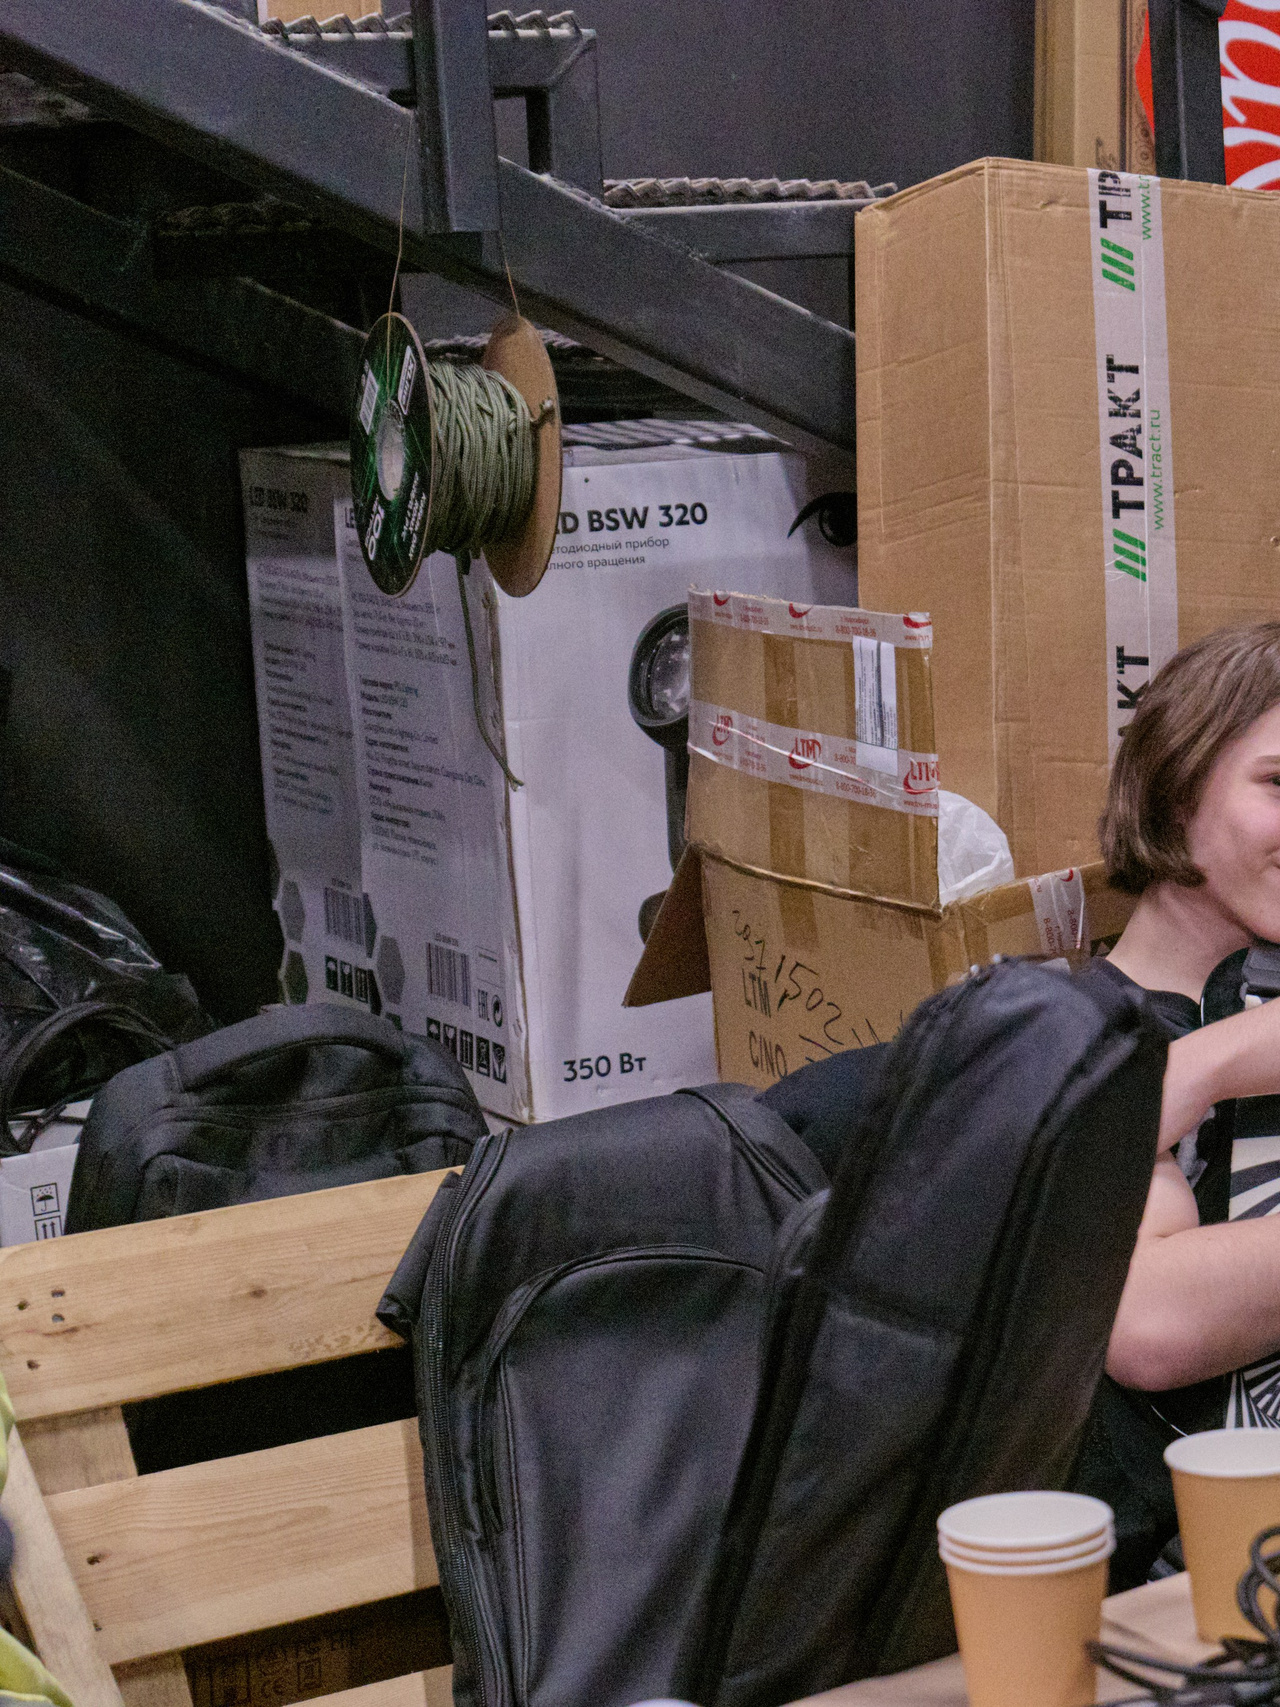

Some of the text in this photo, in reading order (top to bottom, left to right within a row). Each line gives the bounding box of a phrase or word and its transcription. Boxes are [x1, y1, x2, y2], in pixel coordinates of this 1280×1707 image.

[1105, 354, 1145, 519] ТРАКТ
[1149, 409, 1164, 530] www.tract.ru
[368, 504, 385, 561] 100
[555, 501, 708, 535] D BSW 320
[587, 554, 646, 571] вращения
[625, 536, 670, 551] прибор
[1116, 645, 1149, 737] КТ
[563, 1052, 647, 1082] 350 Вт
